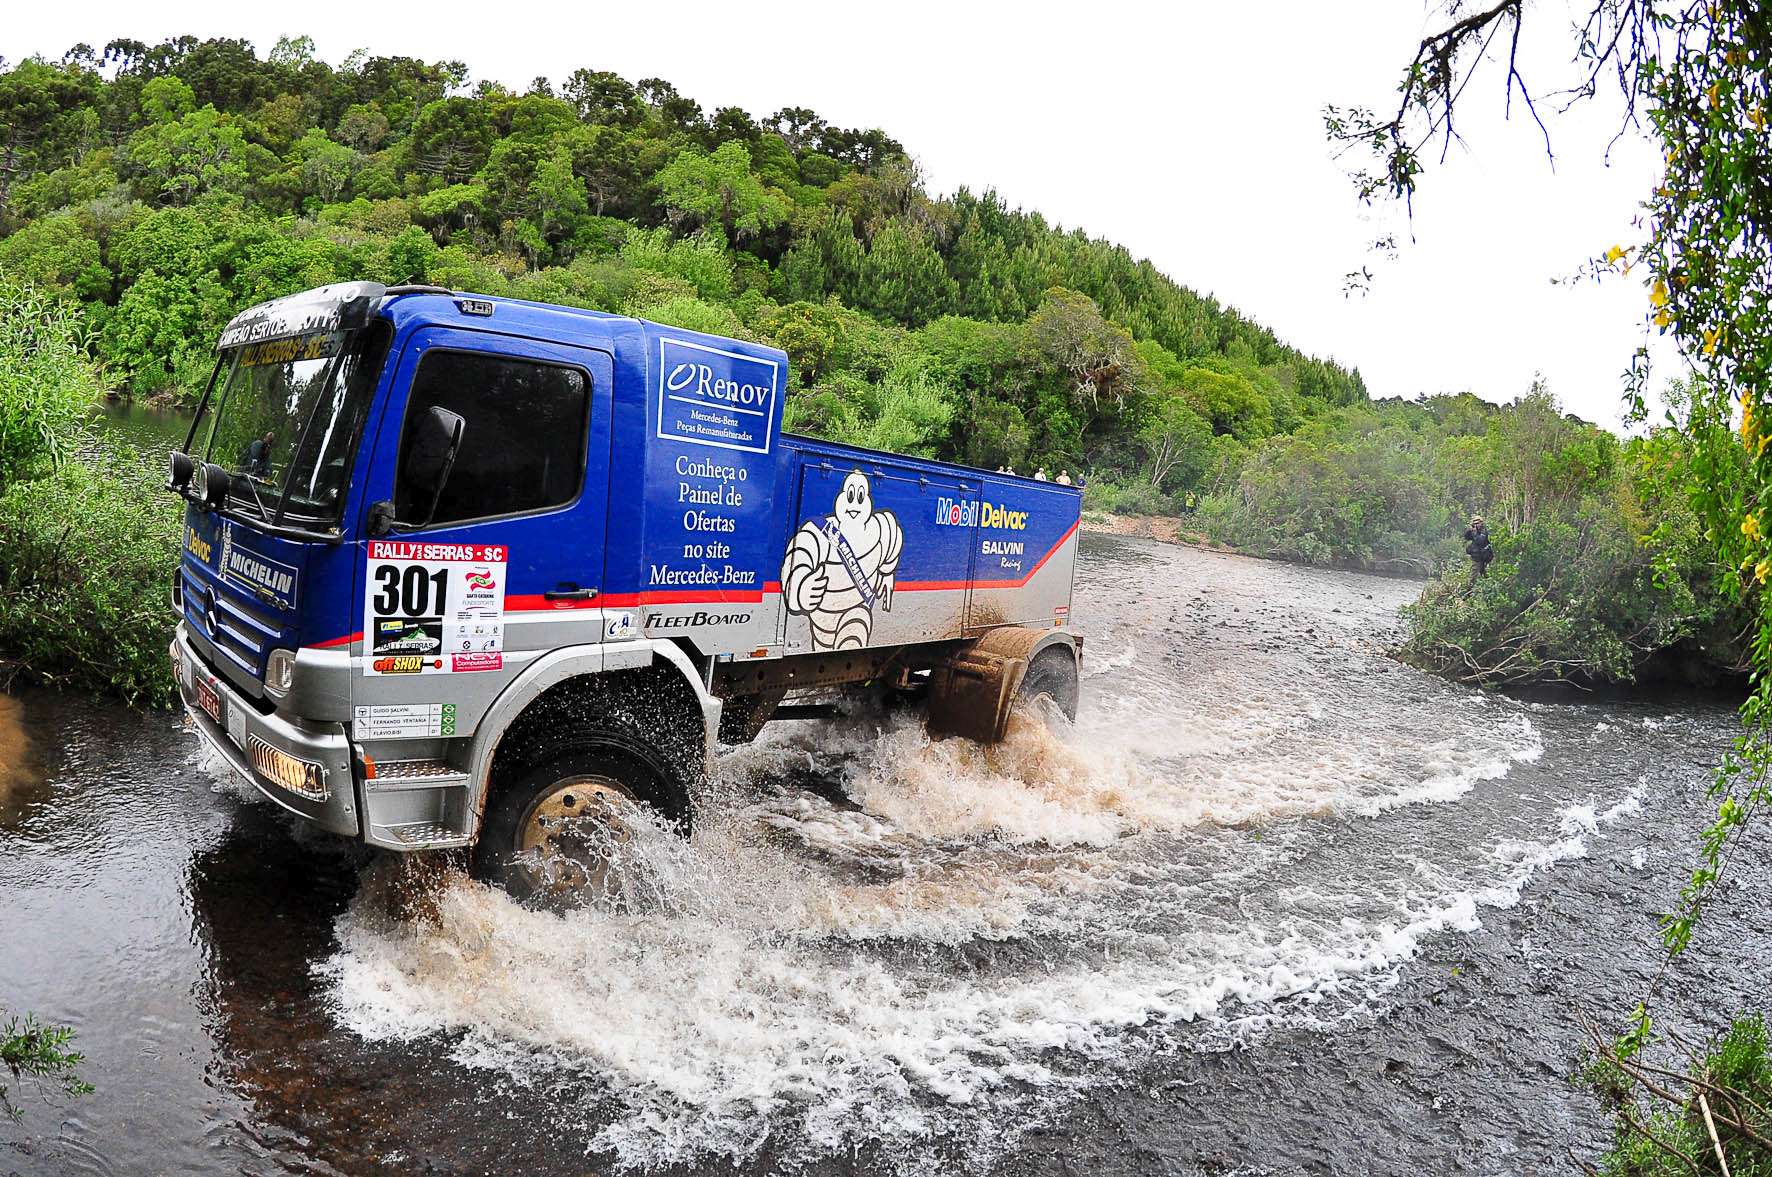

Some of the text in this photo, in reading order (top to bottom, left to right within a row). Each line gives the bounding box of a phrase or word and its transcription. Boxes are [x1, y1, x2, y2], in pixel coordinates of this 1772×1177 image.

[691, 409, 739, 427] Mercedes-Benz
[676, 420, 753, 442] Peças Remanufaturadas
[675, 455, 748, 485] Conheça o
[678, 482, 742, 507] Painel de
[683, 510, 735, 532] Ofertas
[936, 497, 1028, 531] Mobil Delvac
[188, 527, 211, 564] Delvac
[374, 542, 418, 560] RALLY
[423, 545, 474, 561] SERRAS
[483, 547, 503, 561] SC
[683, 540, 730, 559] no site
[981, 540, 1024, 555] SALVINI
[230, 551, 293, 594] MICHELIN
[649, 564, 755, 585] Mercedes-Benz
[840, 541, 873, 598] MICHELIN
[1000, 557, 1022, 571] Racing
[373, 564, 449, 617] 301
